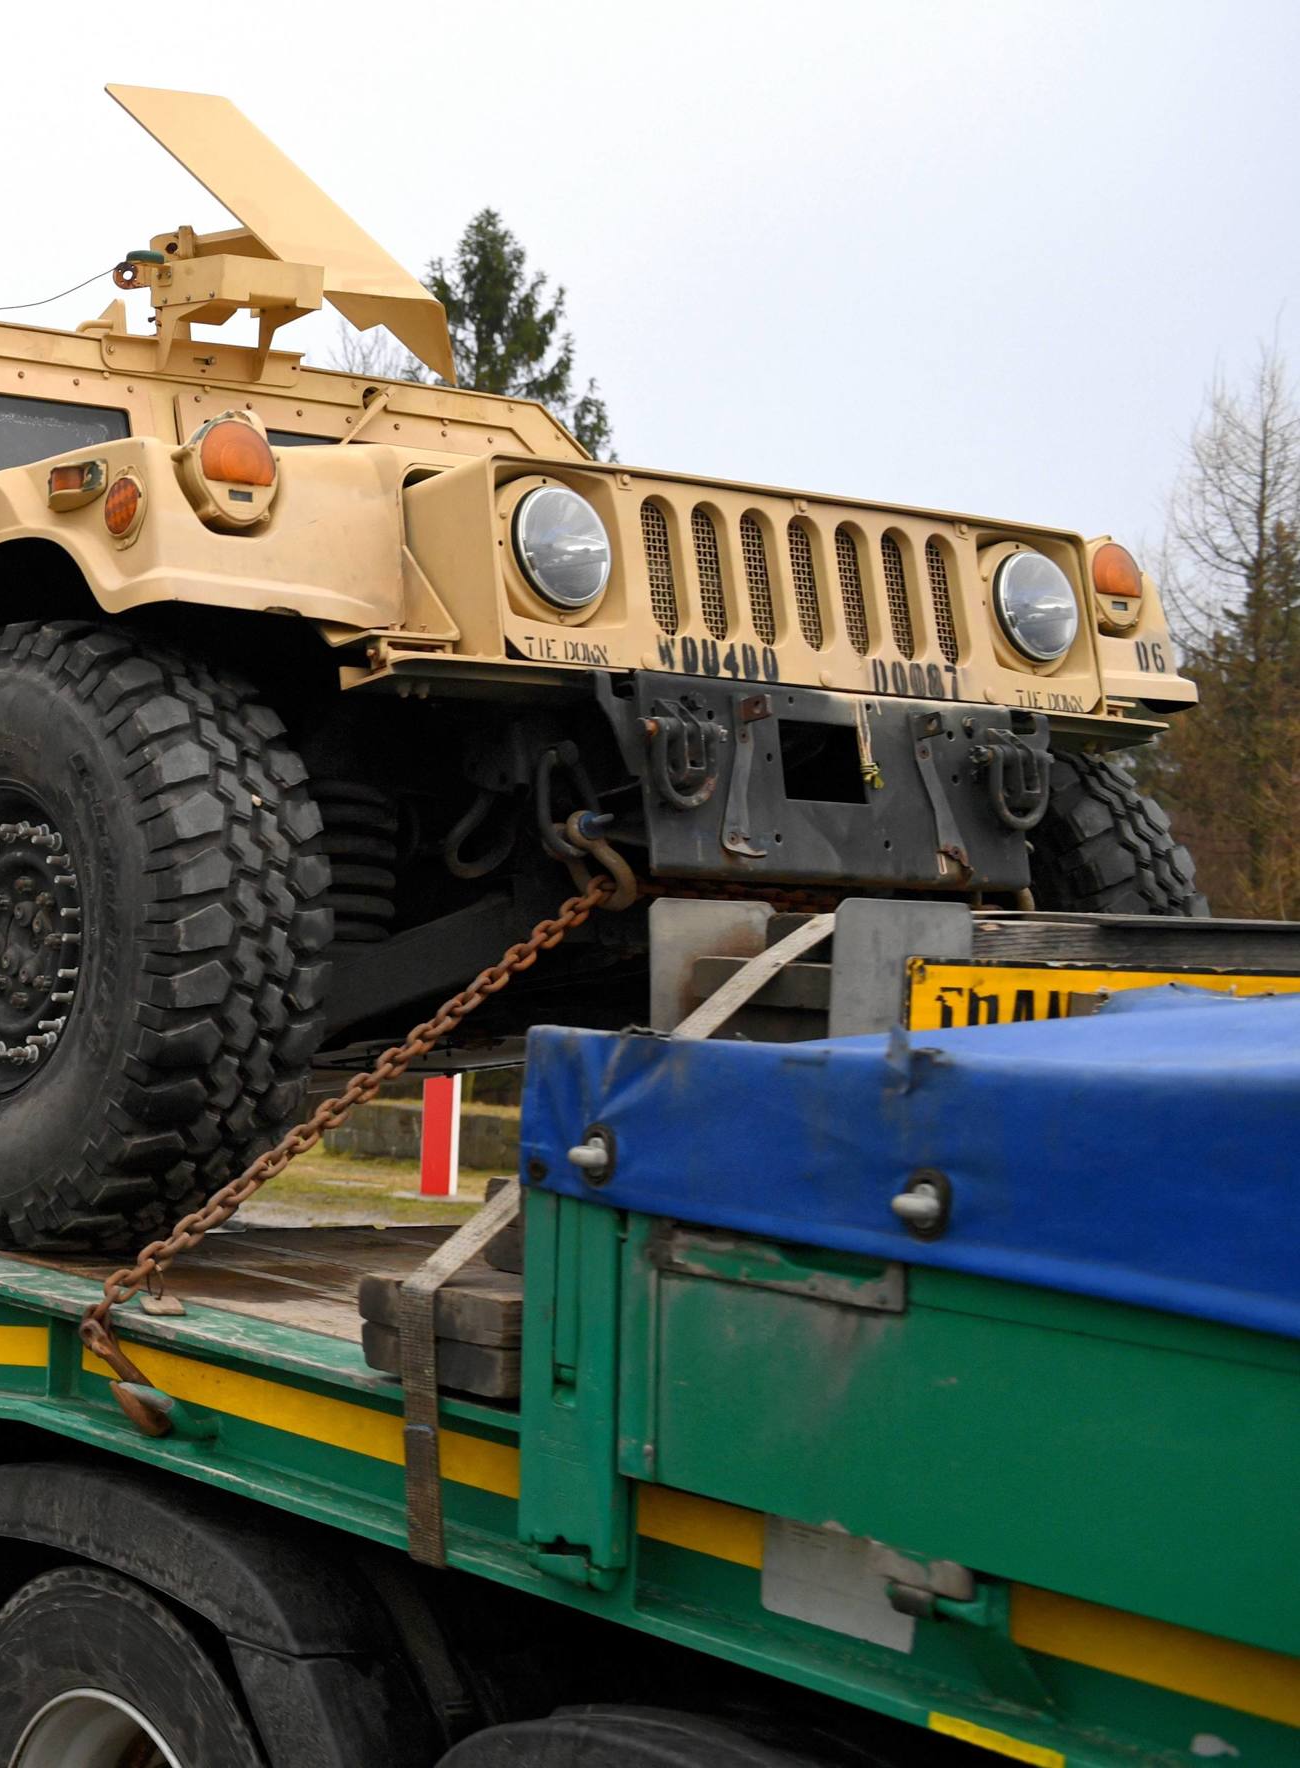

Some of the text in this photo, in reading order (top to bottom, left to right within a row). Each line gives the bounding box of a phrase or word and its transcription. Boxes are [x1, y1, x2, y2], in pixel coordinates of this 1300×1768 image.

[523, 635, 609, 665] TIE DOWN
[1014, 689, 1085, 713] TIE DOWN
